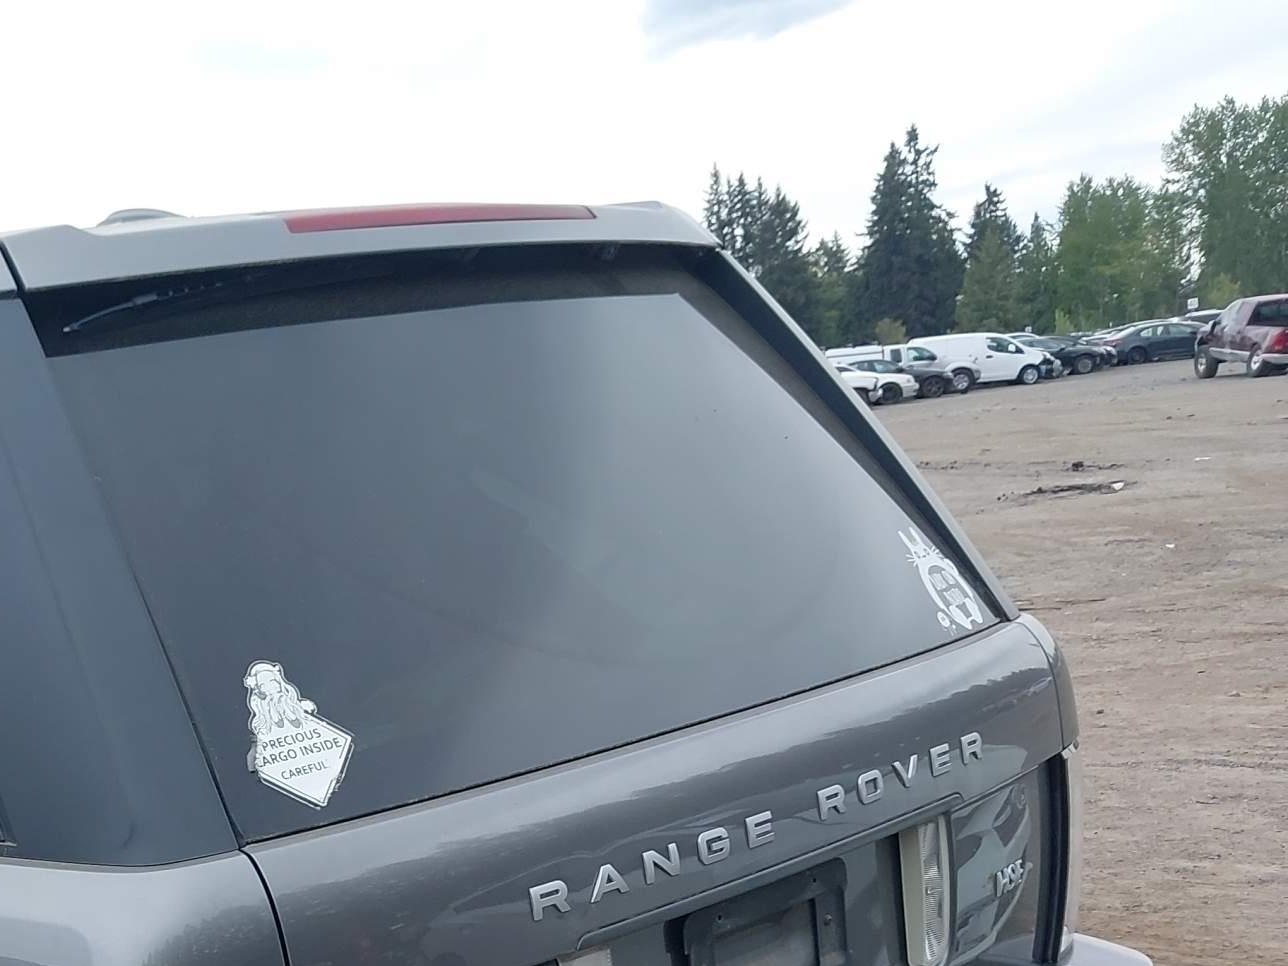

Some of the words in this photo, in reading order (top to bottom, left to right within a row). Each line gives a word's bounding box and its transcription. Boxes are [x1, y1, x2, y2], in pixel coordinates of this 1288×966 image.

[262, 728, 322, 751] PRECIOUS
[299, 737, 342, 757] INSIDE
[281, 760, 328, 780] CAREFUL
[528, 811, 777, 922] RANGE
[817, 731, 985, 821] ROVER
